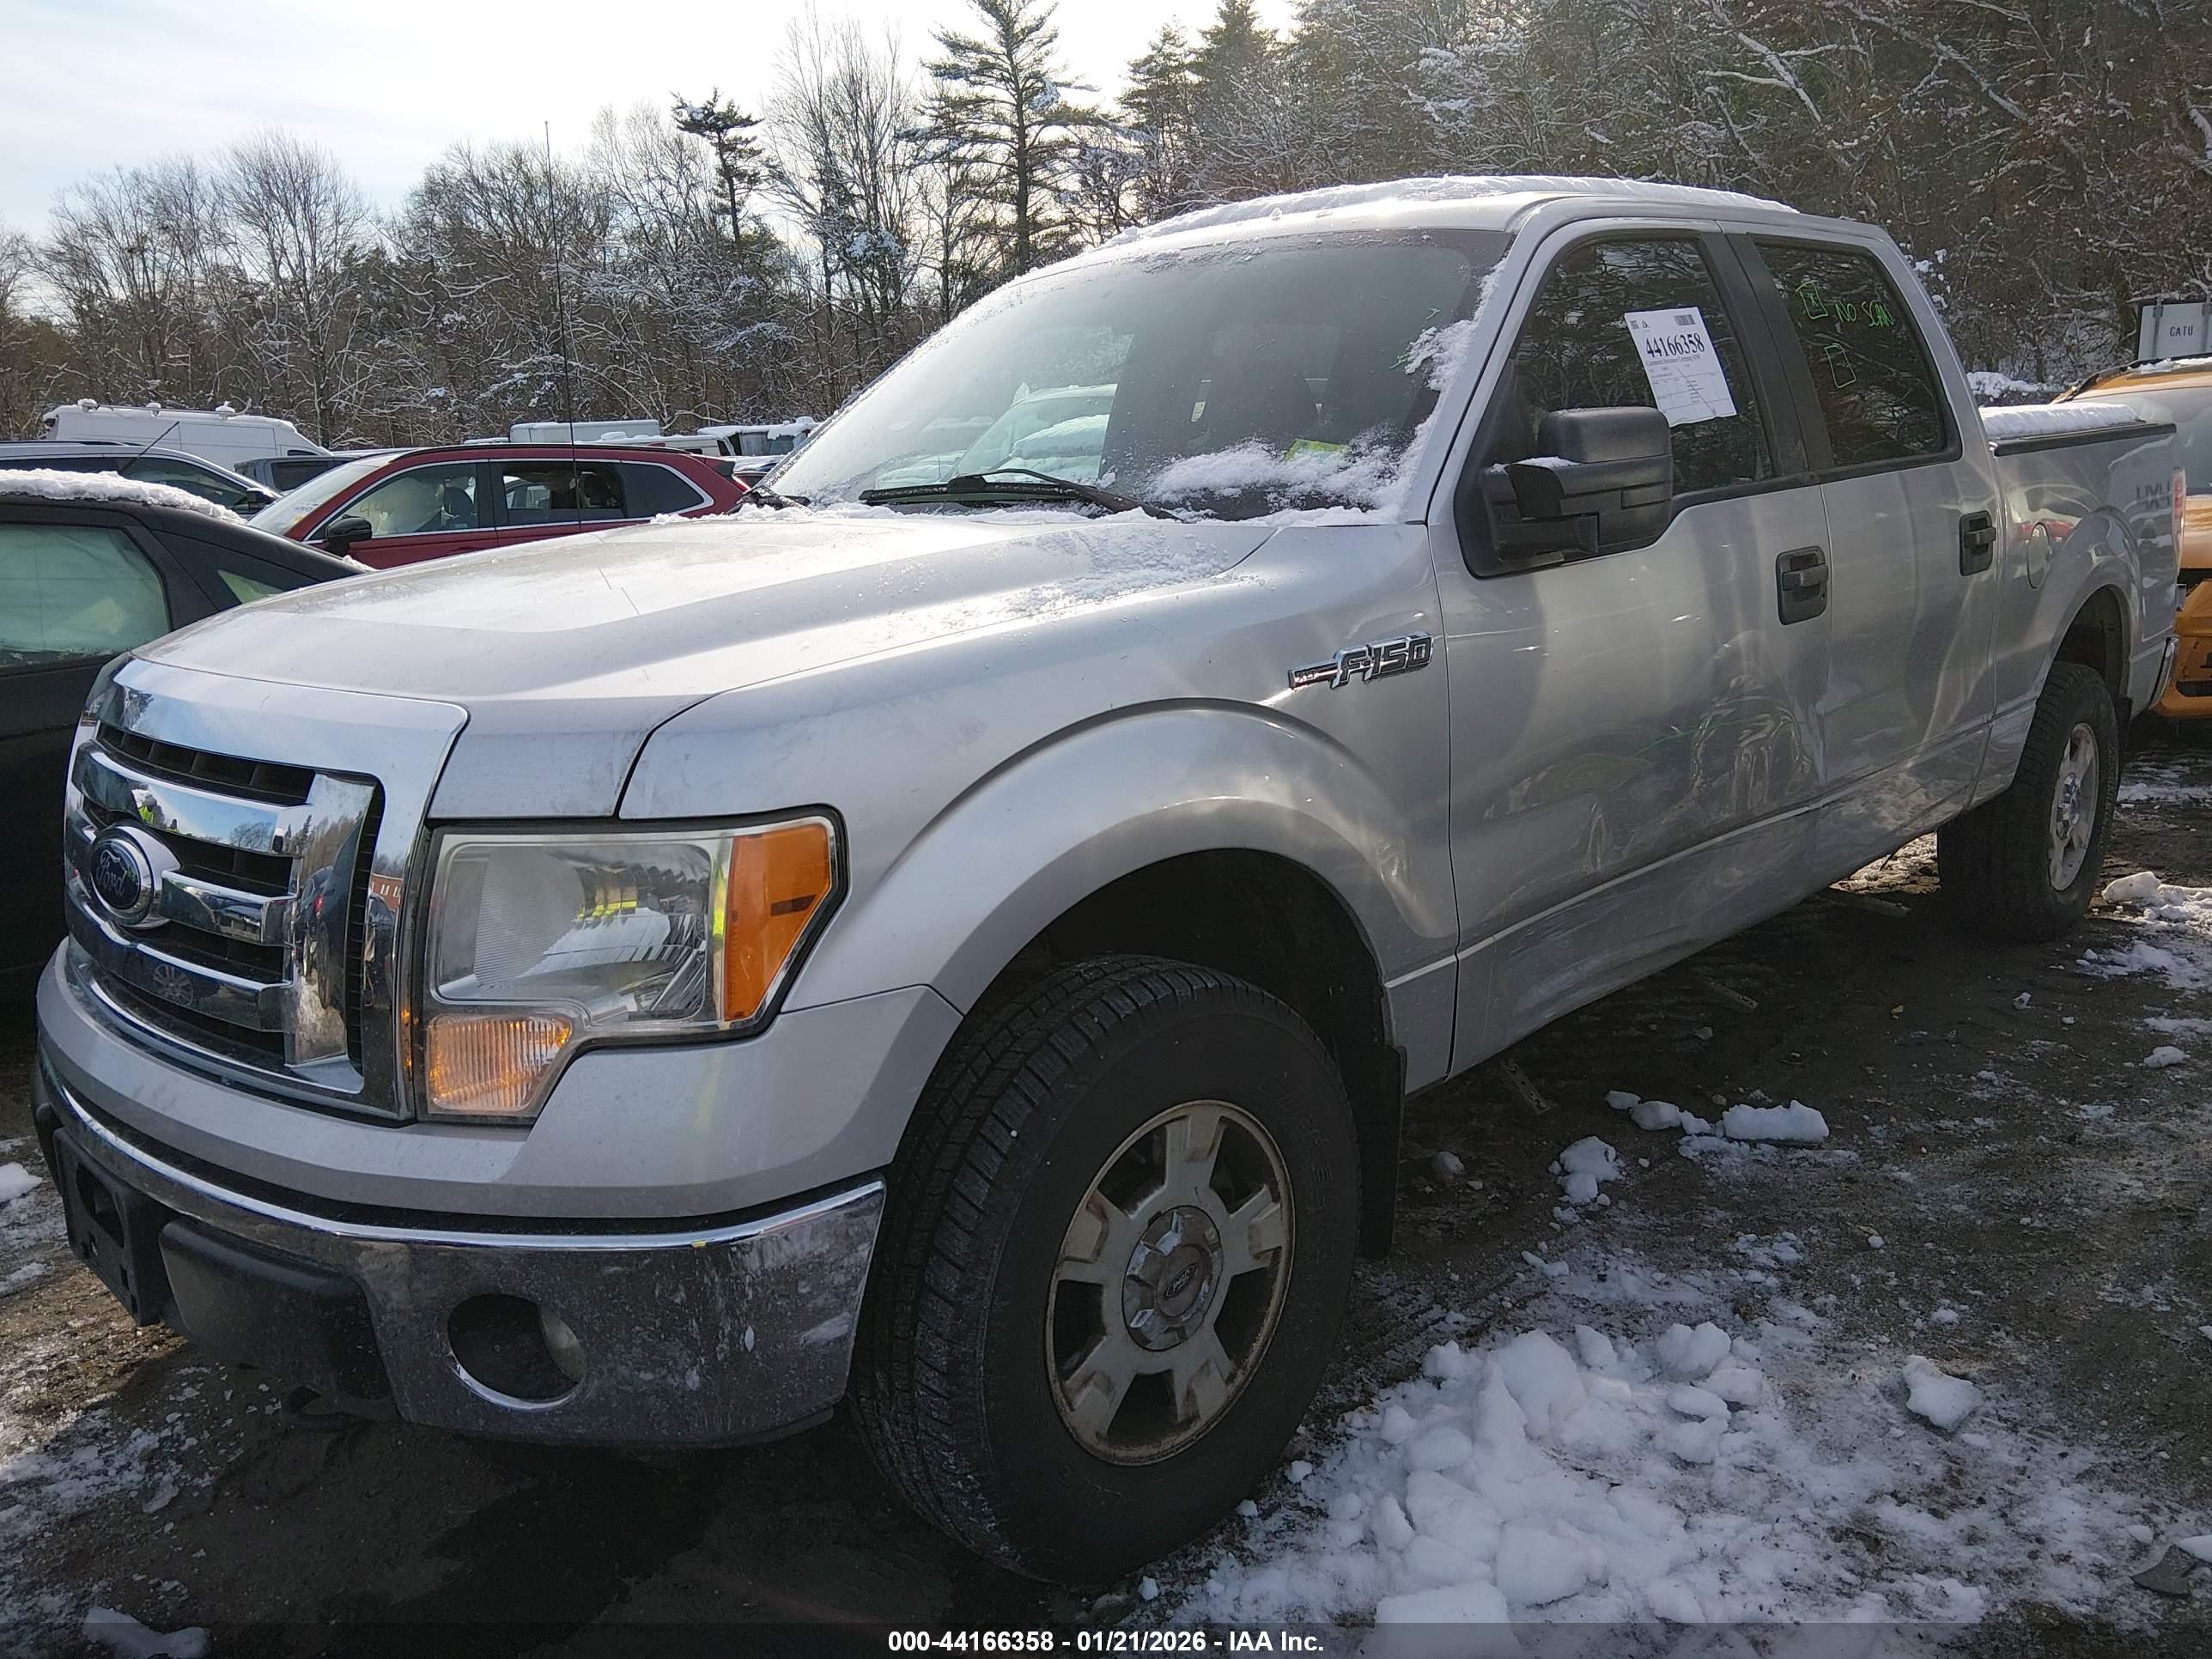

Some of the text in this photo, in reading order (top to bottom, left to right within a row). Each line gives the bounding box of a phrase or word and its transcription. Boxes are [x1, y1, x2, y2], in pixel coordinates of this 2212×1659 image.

[1835, 301, 1857, 323] NO
[2169, 325, 2194, 337] GATU
[1645, 332, 1705, 358] 44166358
[95, 848, 128, 896] Ford
